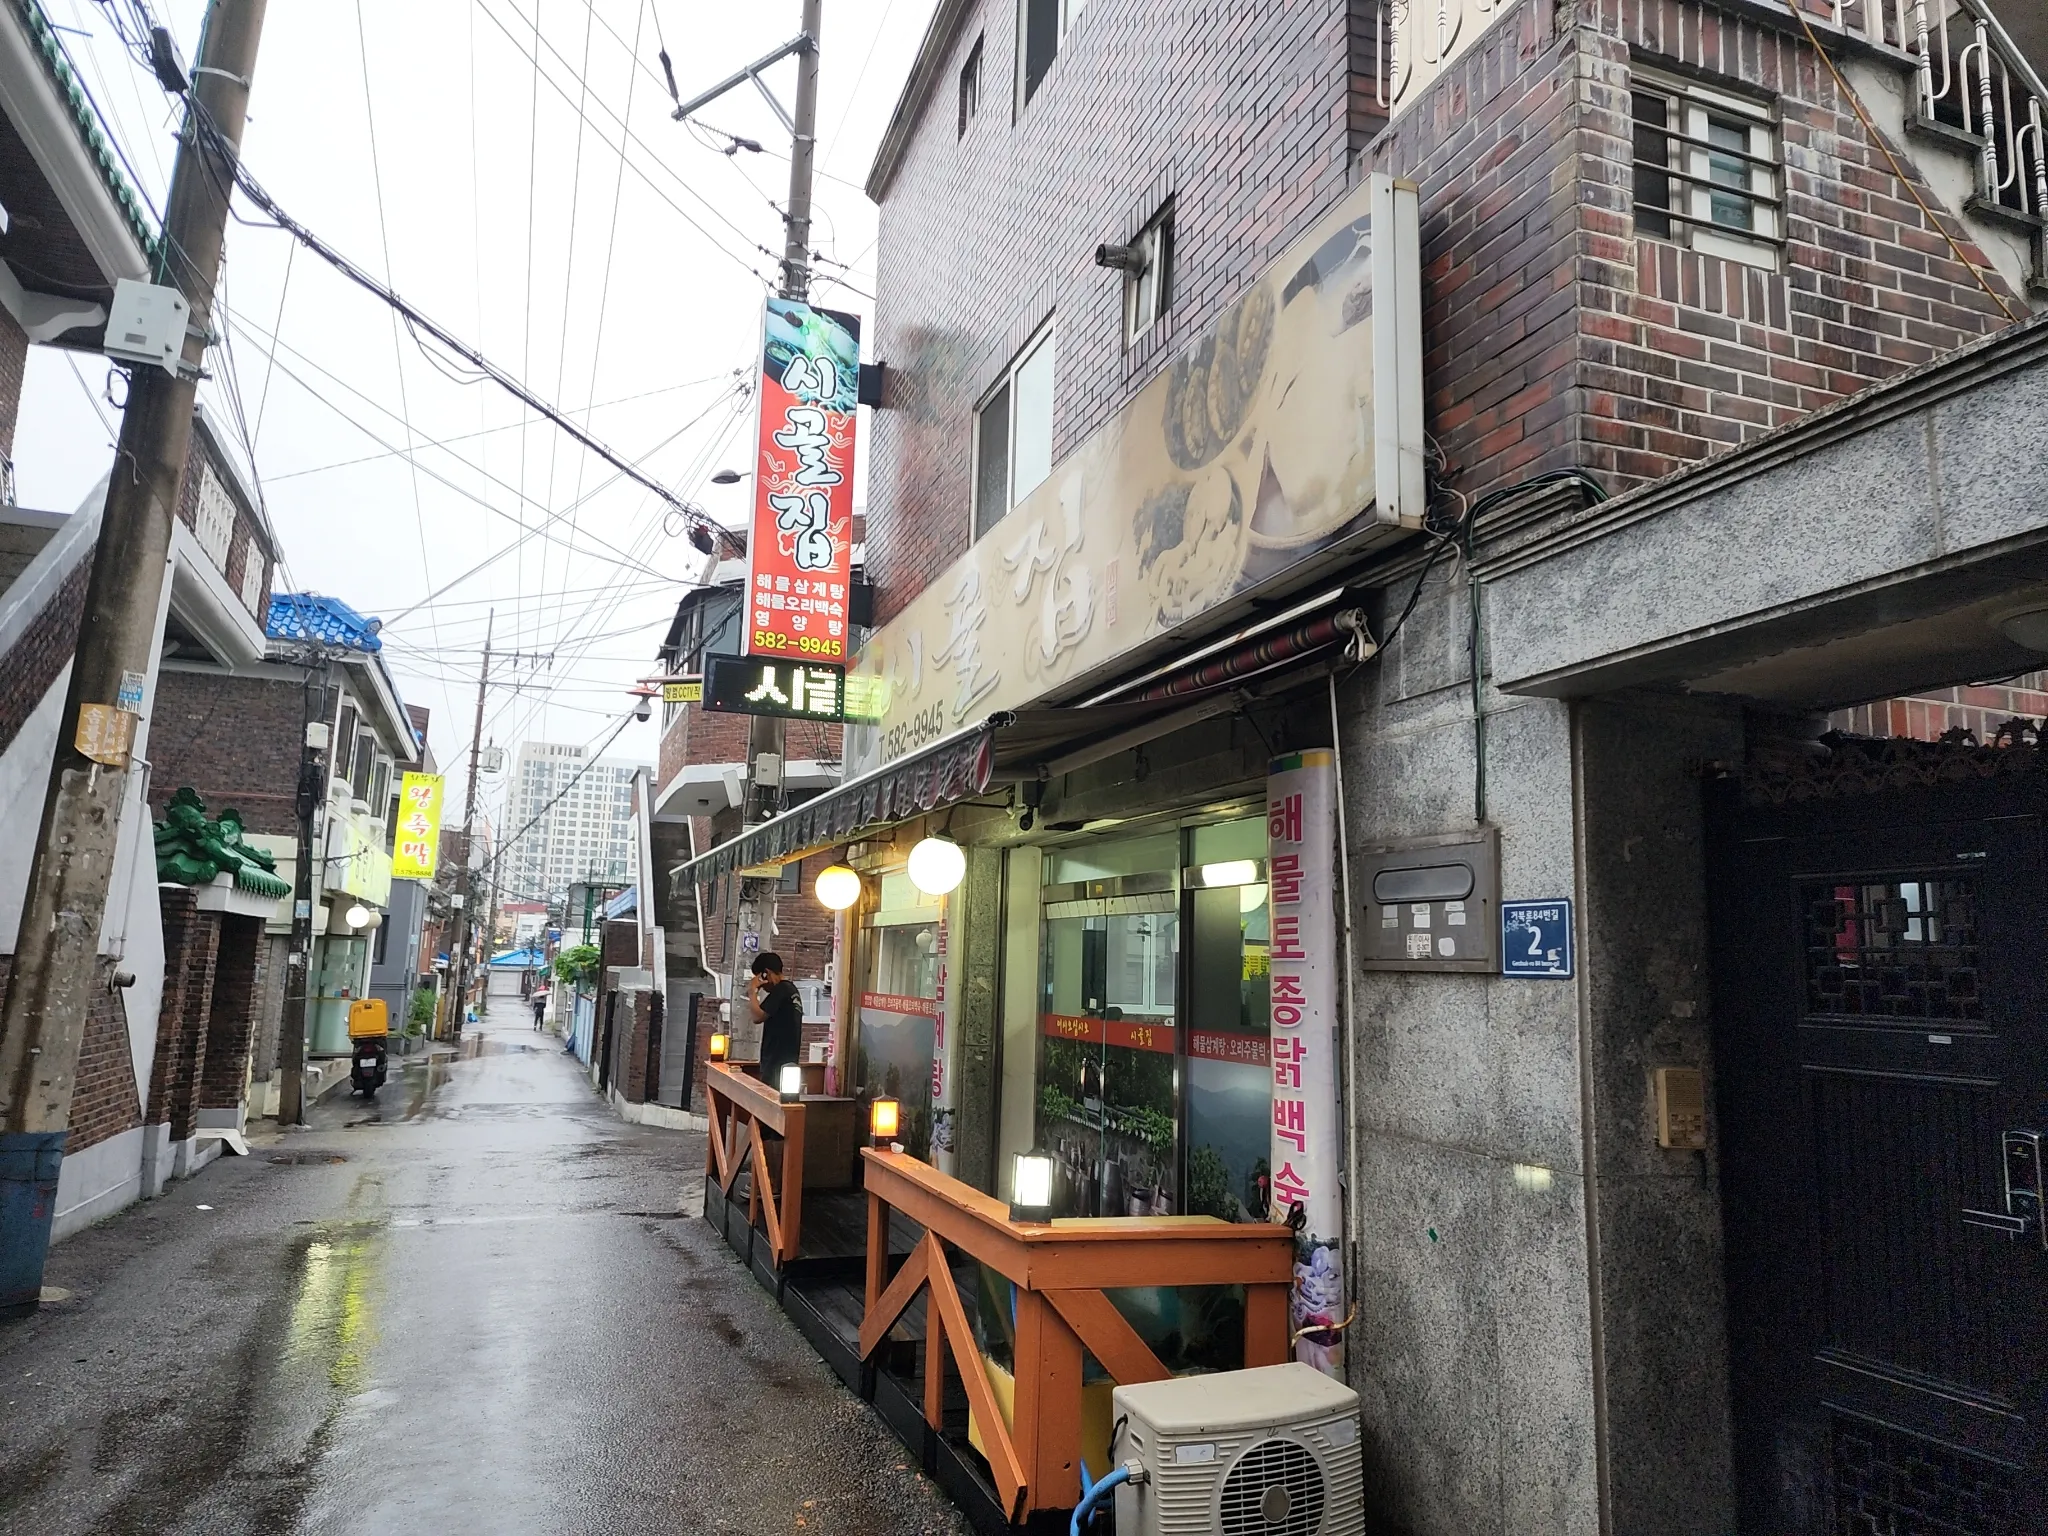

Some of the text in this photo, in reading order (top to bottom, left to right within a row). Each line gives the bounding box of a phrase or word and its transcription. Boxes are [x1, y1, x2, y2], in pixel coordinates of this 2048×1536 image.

[769, 354, 843, 570] 시골집
[756, 573, 845, 599] 해물삼계탕
[755, 592, 844, 618] 해물오리백숙
[754, 631, 842, 656] 582-9945
[404, 788, 432, 865] 왕족발
[1527, 926, 1543, 956] 2
[1270, 794, 1309, 1208] 해물토종닭백숙
[1130, 1027, 1153, 1047] 시골집
